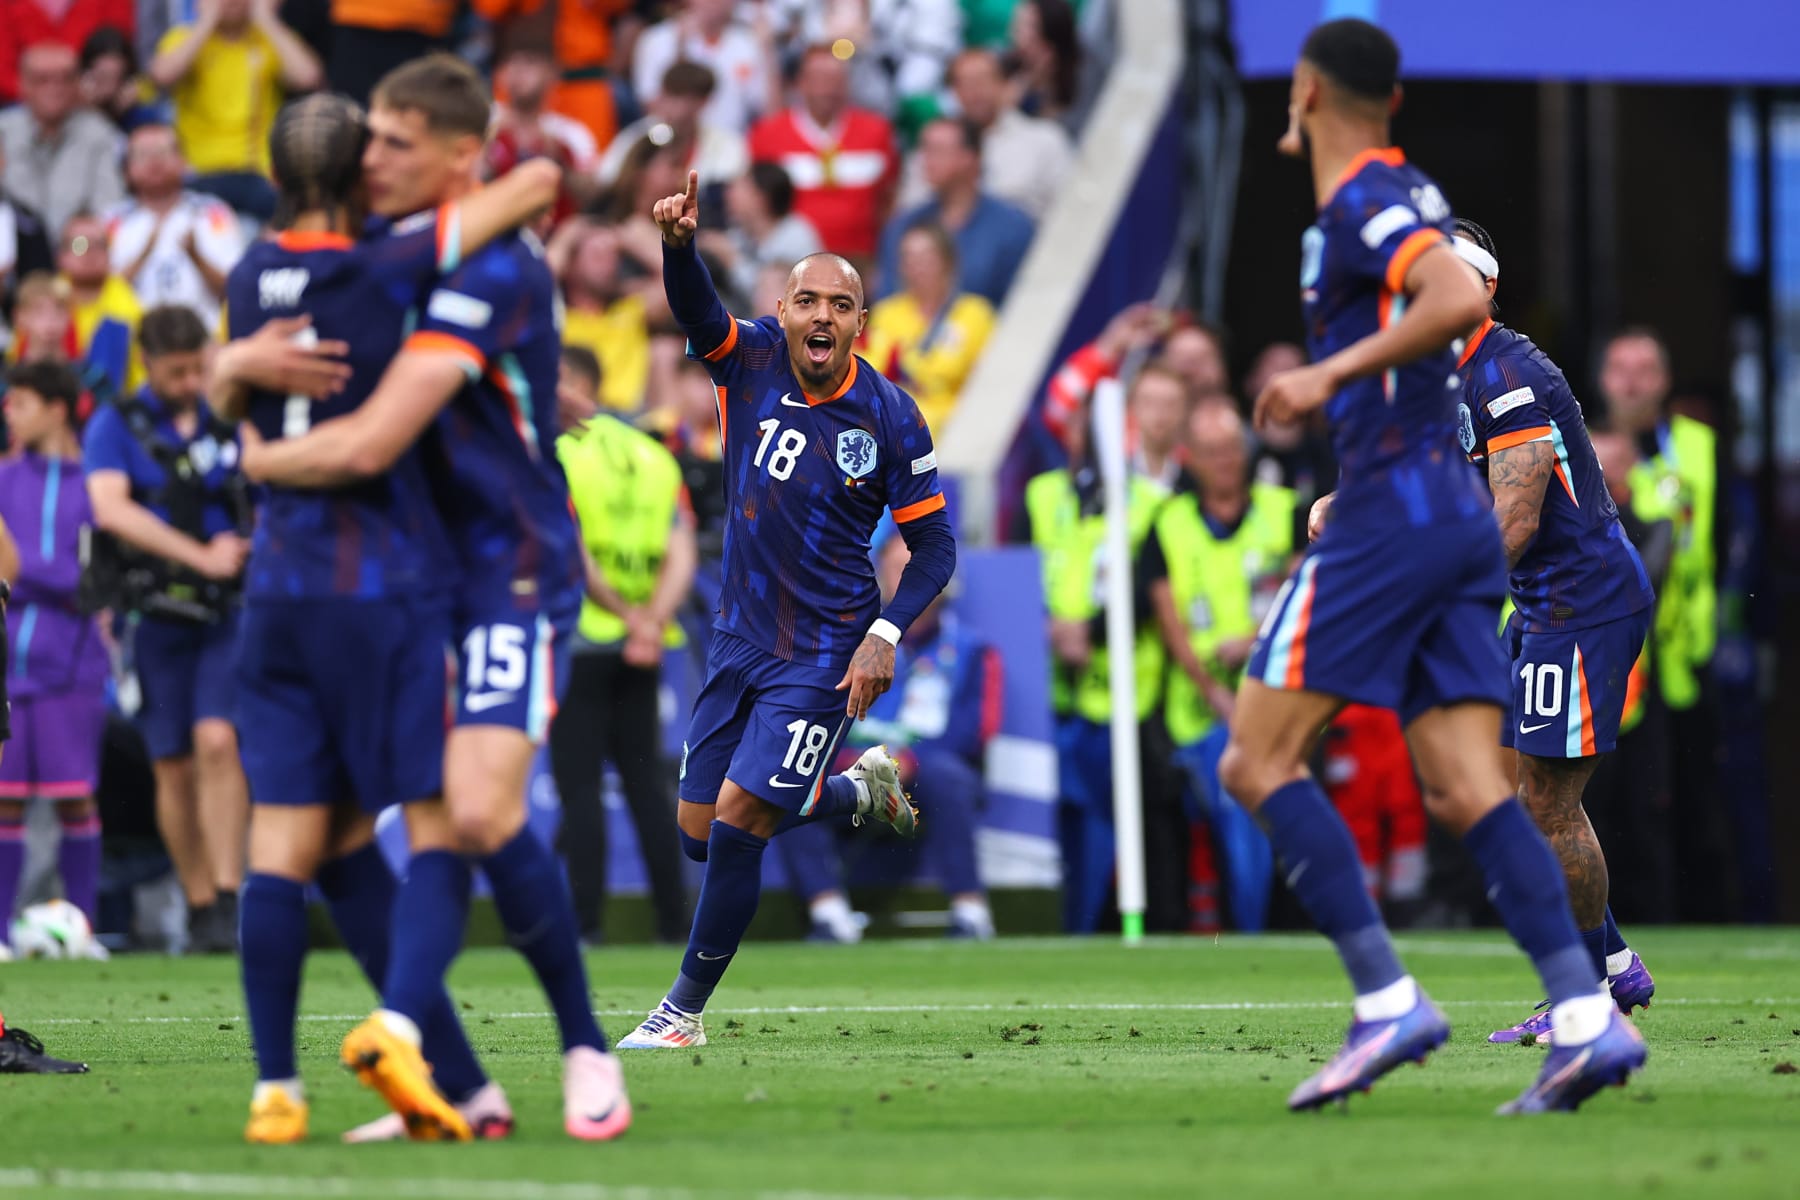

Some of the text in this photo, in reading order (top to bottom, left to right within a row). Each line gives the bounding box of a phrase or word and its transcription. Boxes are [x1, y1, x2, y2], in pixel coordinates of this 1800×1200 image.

[753, 418, 807, 481] 18
[462, 623, 527, 690] 15
[1519, 662, 1563, 717] 10
[782, 718, 828, 776] 18
